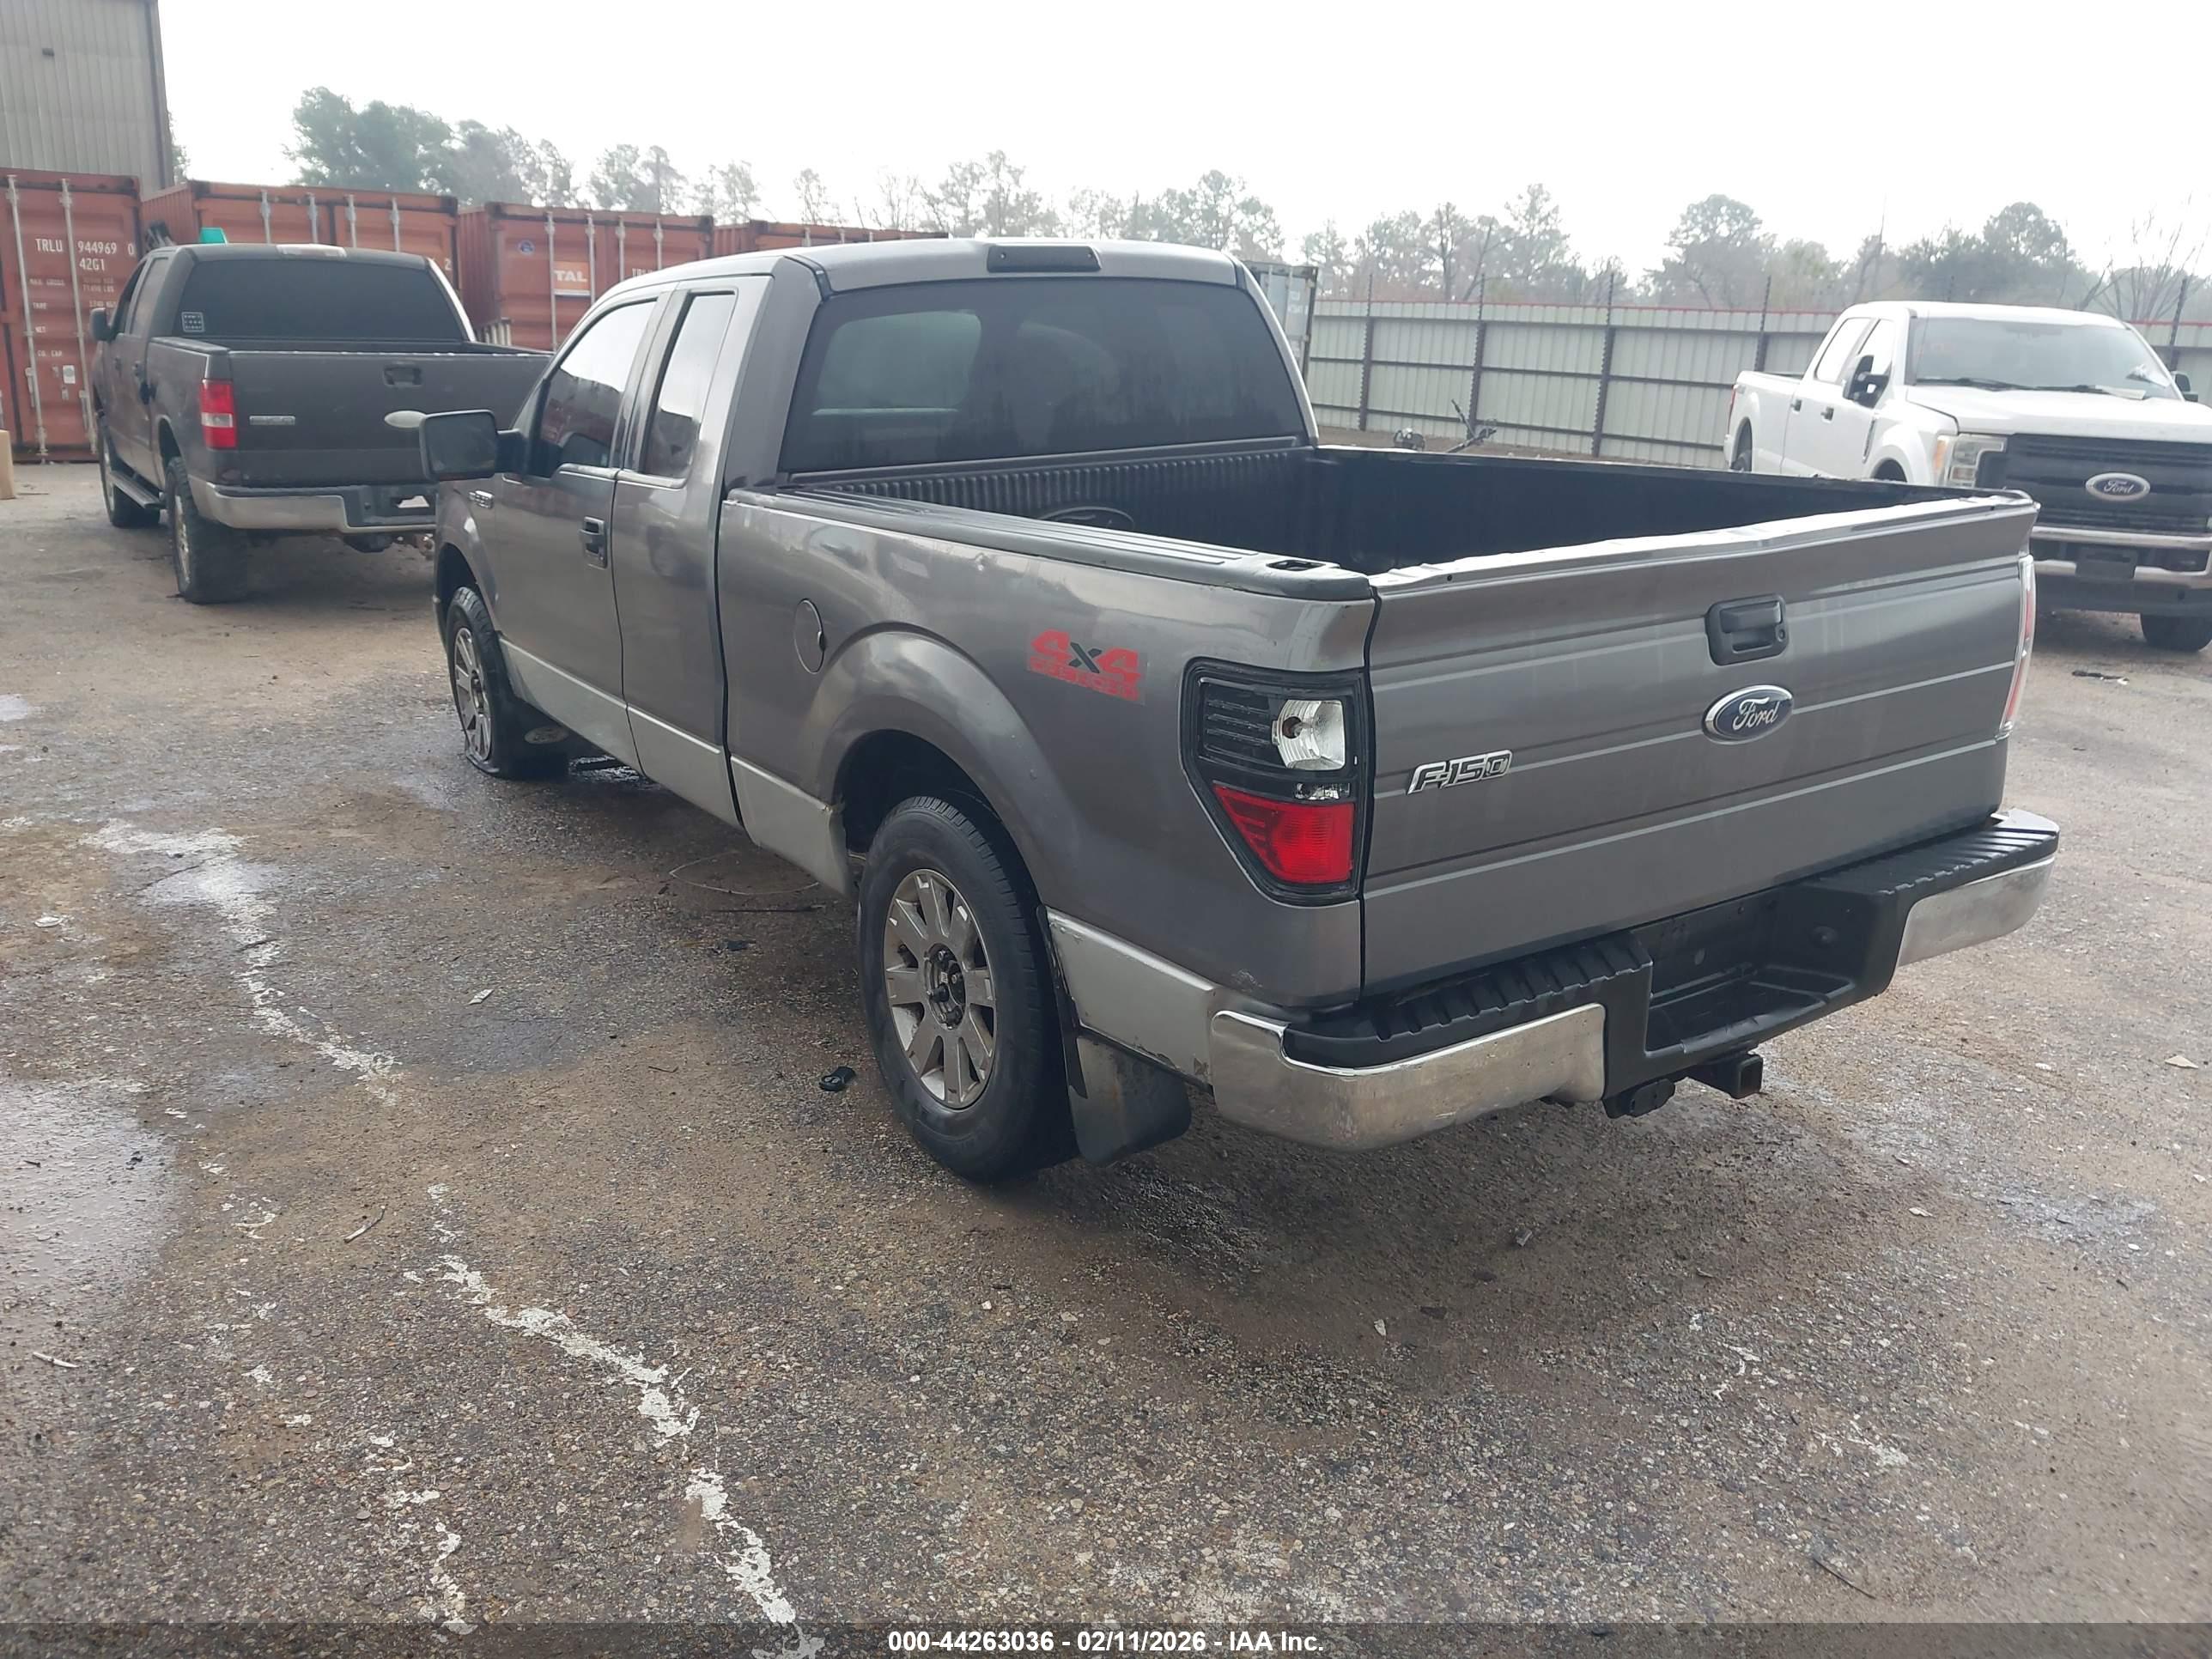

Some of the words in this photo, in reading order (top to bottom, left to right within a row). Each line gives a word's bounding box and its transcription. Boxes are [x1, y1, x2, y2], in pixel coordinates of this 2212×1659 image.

[34, 239, 64, 252] TRLU
[77, 240, 118, 255] 944969
[79, 258, 105, 271] 42G1
[554, 270, 588, 283] TAL
[2104, 480, 2136, 494] Ford
[1733, 696, 1780, 731] Ford
[1407, 749, 1512, 795] F-150
